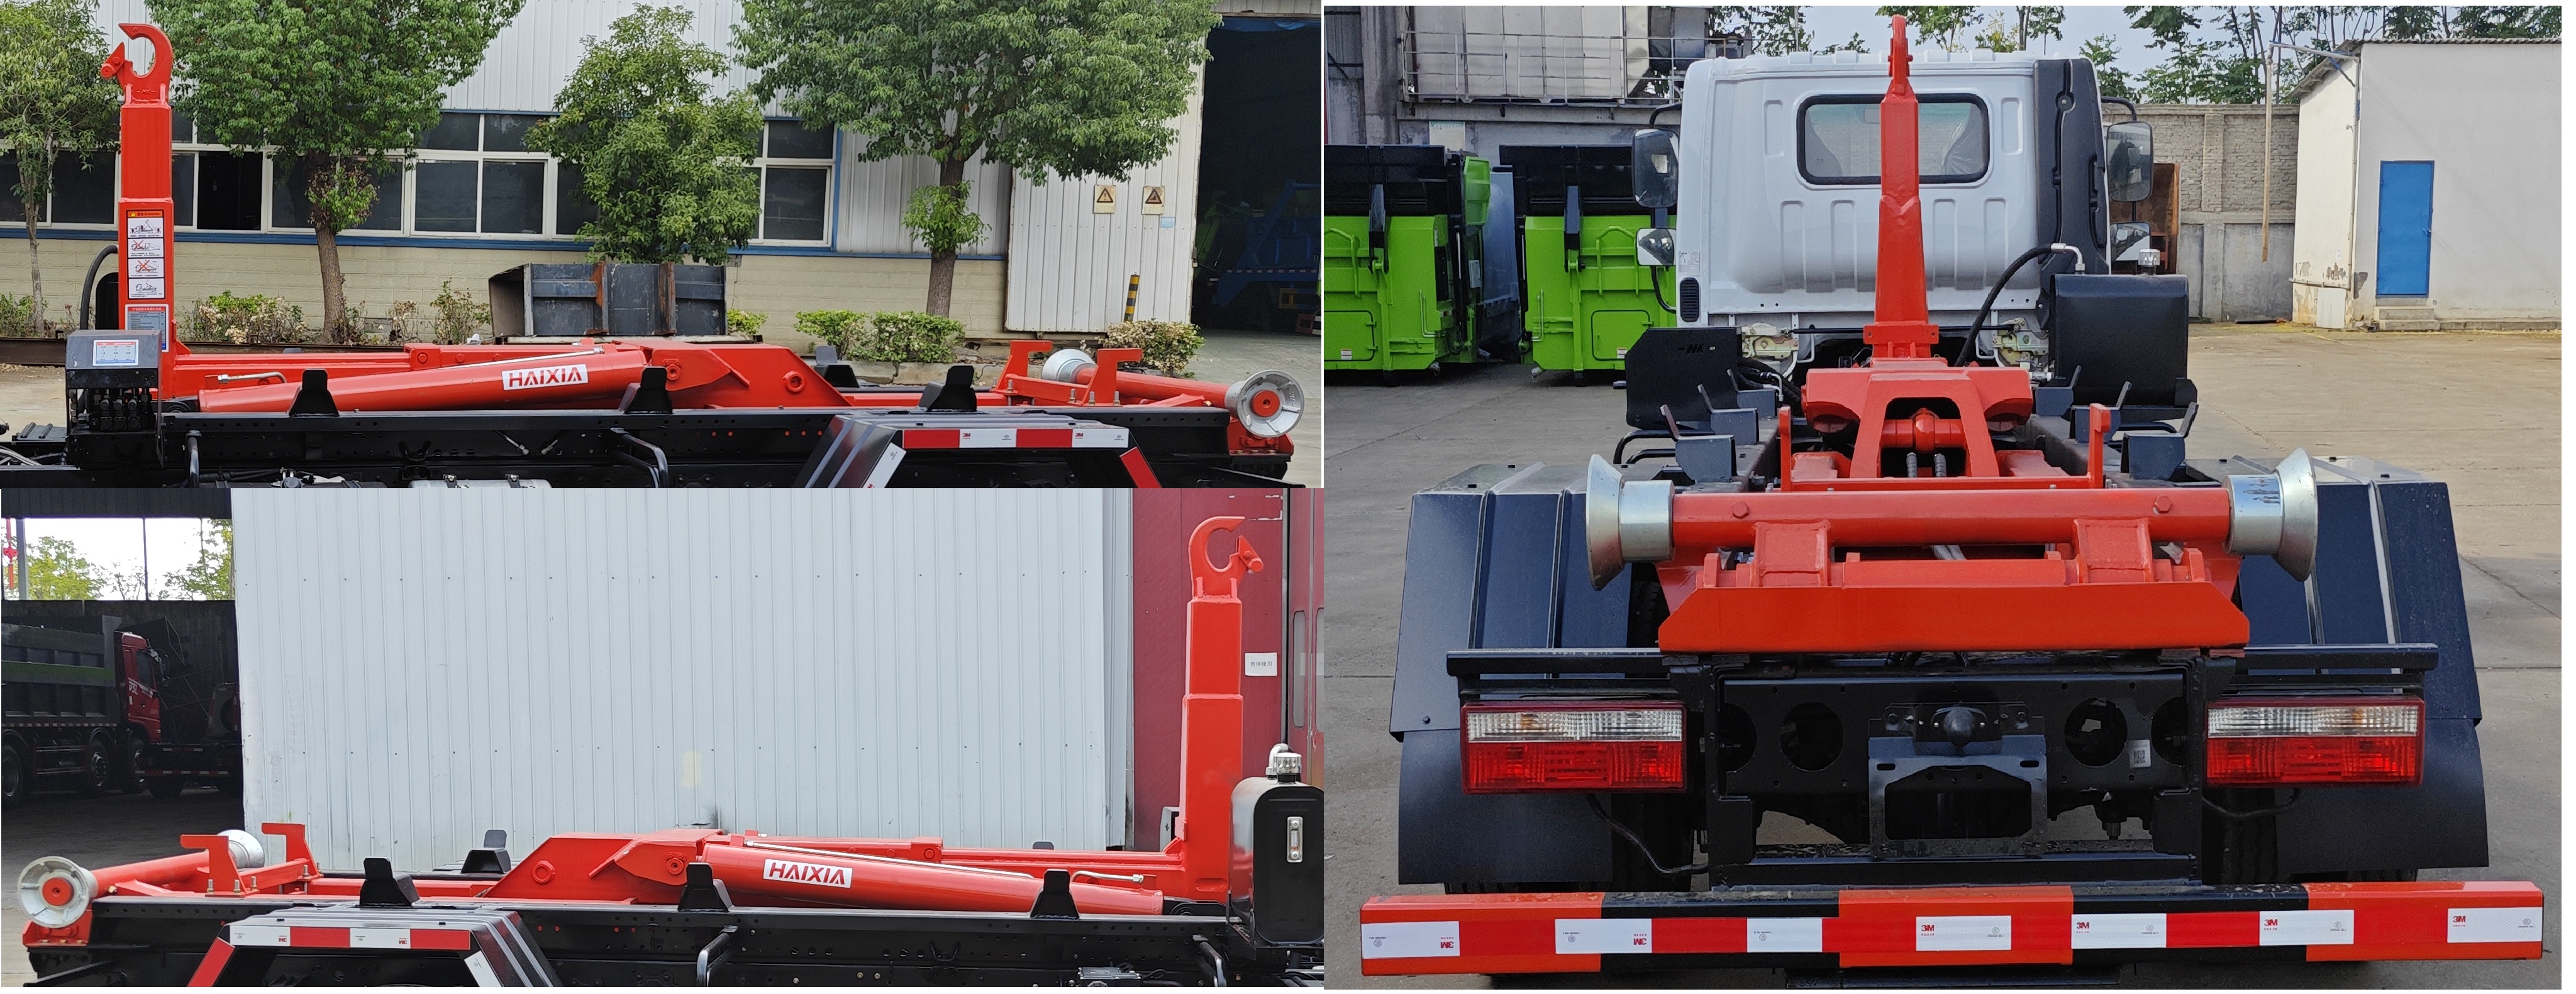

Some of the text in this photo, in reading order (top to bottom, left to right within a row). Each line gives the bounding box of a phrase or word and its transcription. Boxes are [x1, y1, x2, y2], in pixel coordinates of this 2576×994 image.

[509, 367, 582, 387] HAIXIA
[769, 862, 845, 885] HAIXIA
[1633, 937, 1647, 946] 3M
